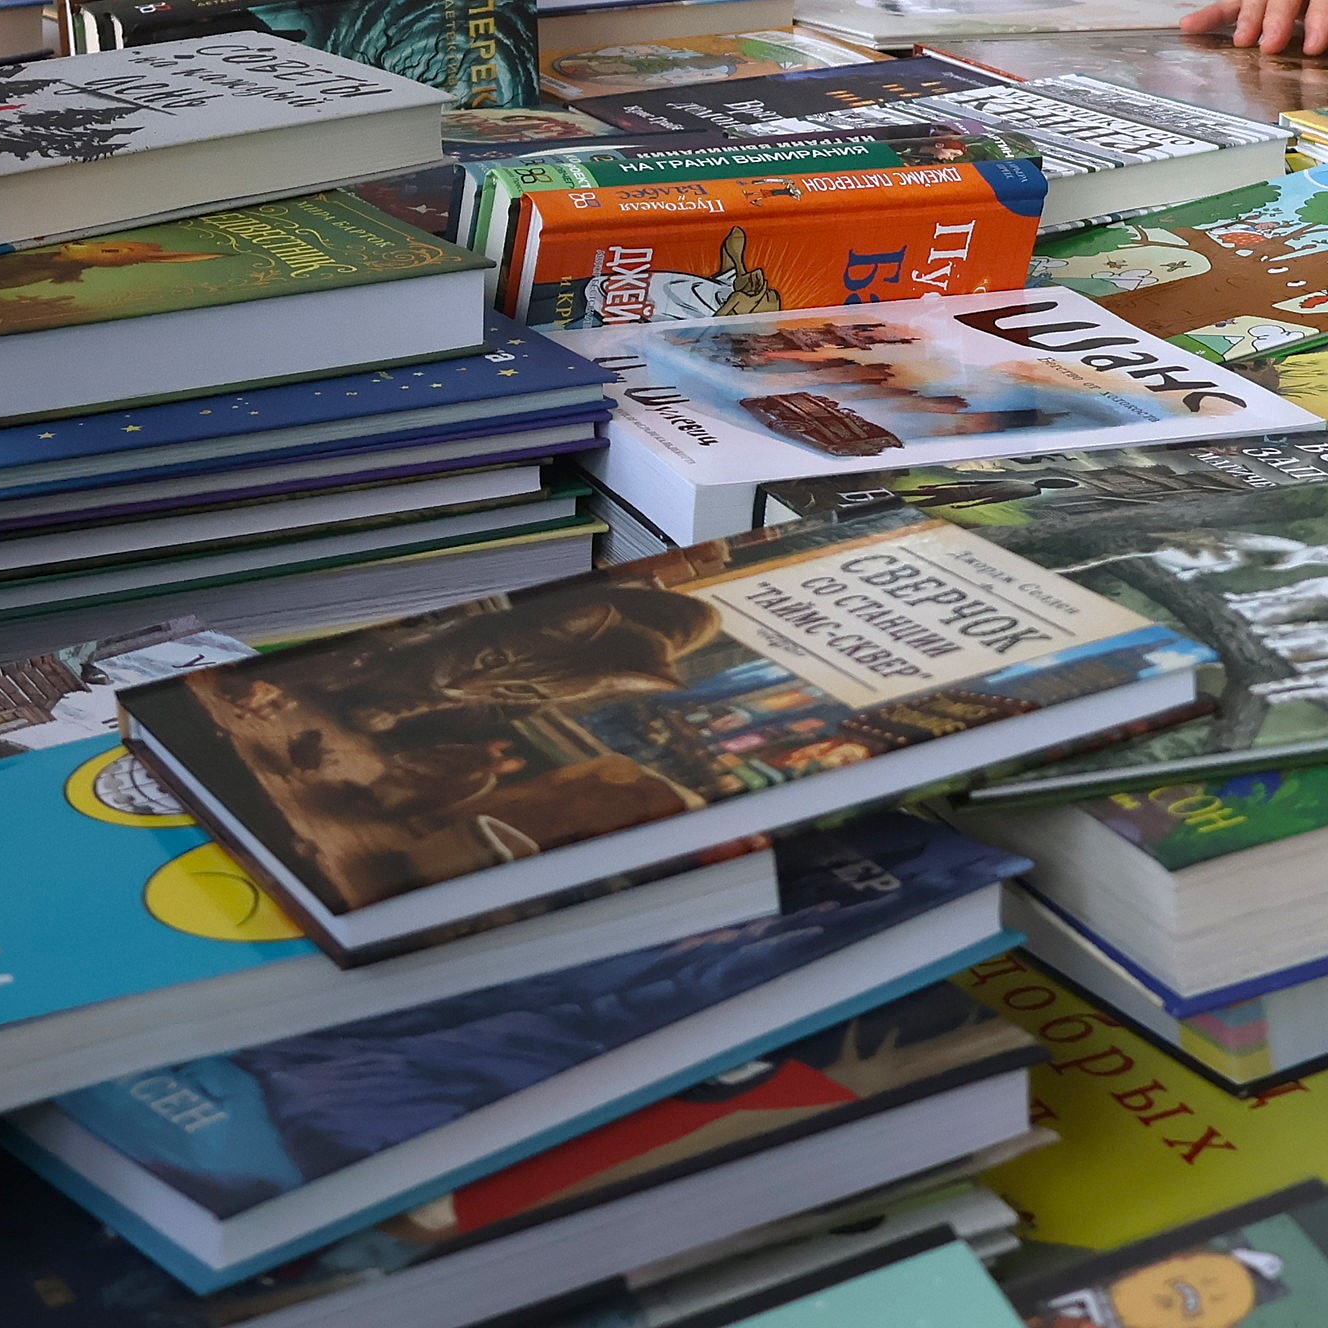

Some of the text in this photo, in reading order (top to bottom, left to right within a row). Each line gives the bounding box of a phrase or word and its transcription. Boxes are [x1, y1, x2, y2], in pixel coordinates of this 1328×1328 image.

[195, 44, 393, 98] СОВЕТЫ
[619, 143, 871, 174] НА ГРАНИ ВЫМИРАНИЯ
[802, 167, 962, 193] ДЖЕЙМС ПАТТЕРСОН
[198, 211, 358, 278] ЕДВЕСТНИК
[600, 246, 654, 324] ДЖЕЙ
[1035, 355, 1083, 385] Бегство
[800, 575, 963, 659] СО СТАНЦИИ
[840, 553, 1053, 655] СВЕРЧОК
[122, 1074, 231, 1136] СЕН
